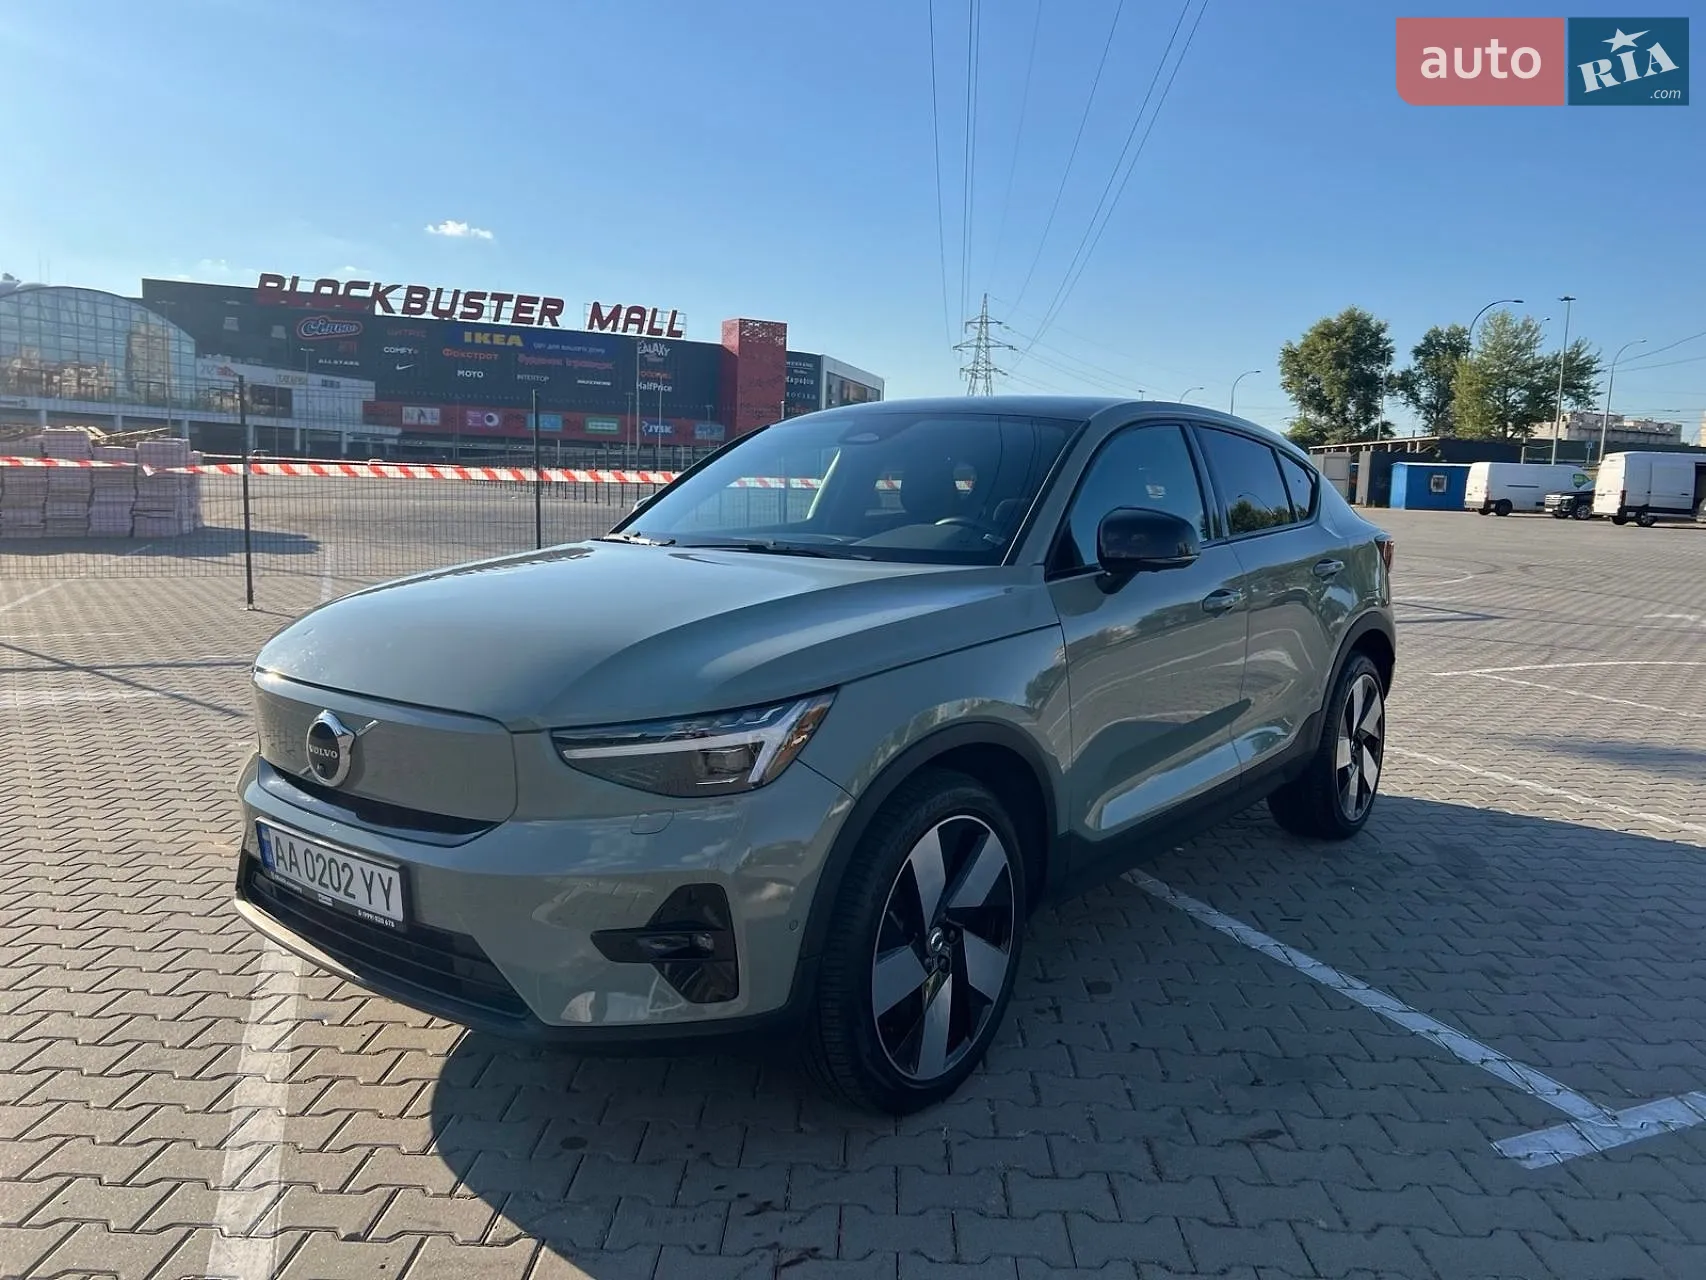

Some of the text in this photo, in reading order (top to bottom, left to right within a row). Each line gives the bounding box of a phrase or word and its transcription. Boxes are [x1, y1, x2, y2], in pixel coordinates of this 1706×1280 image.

[257, 272, 684, 338] BLOCKBUSTER MALL
[463, 330, 525, 347] IKEA
[383, 346, 414, 354] COMFY
[442, 347, 499, 361] Фокстрот
[637, 340, 671, 357] GALAXY
[456, 369, 485, 379] MOYO
[636, 381, 673, 393] HalfPrice
[648, 424, 673, 434] JYSK
[308, 743, 339, 759] VOLVO
[274, 835, 302, 876] AA
[303, 846, 357, 901] 0202
[359, 866, 394, 912] YY
